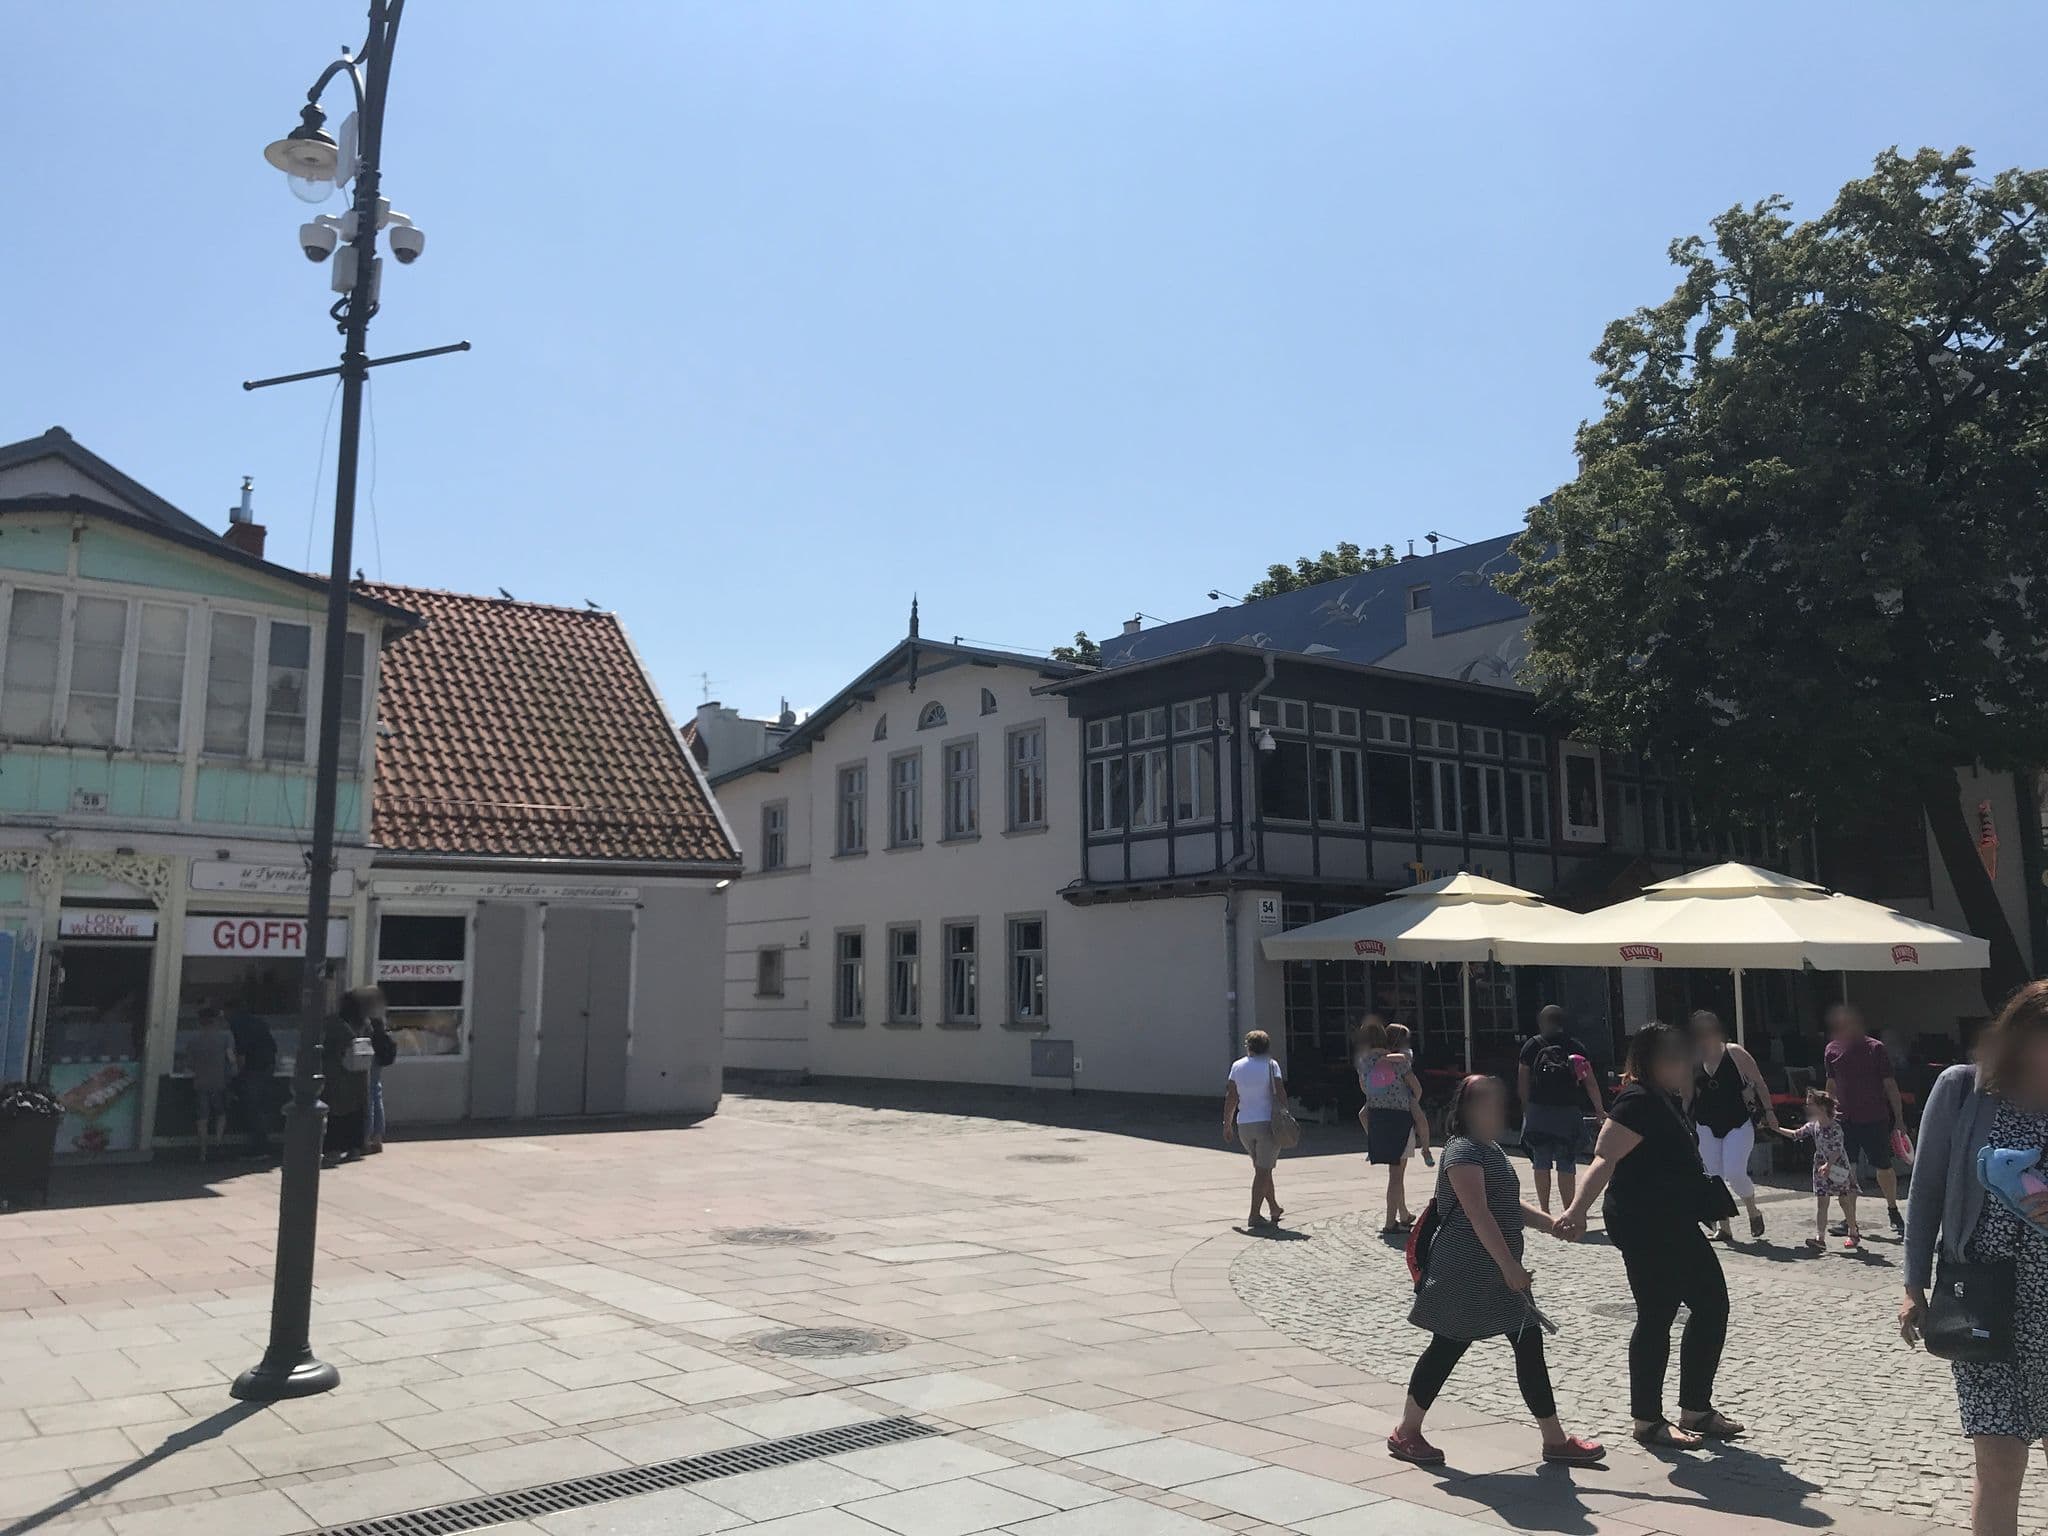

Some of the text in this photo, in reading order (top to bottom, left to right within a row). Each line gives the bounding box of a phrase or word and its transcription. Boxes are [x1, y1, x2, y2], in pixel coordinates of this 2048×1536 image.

[1262, 901, 1274, 913] 54
[85, 913, 127, 925] LODY
[212, 920, 308, 950] GOFR
[379, 964, 455, 976] ZAPIEKSY
